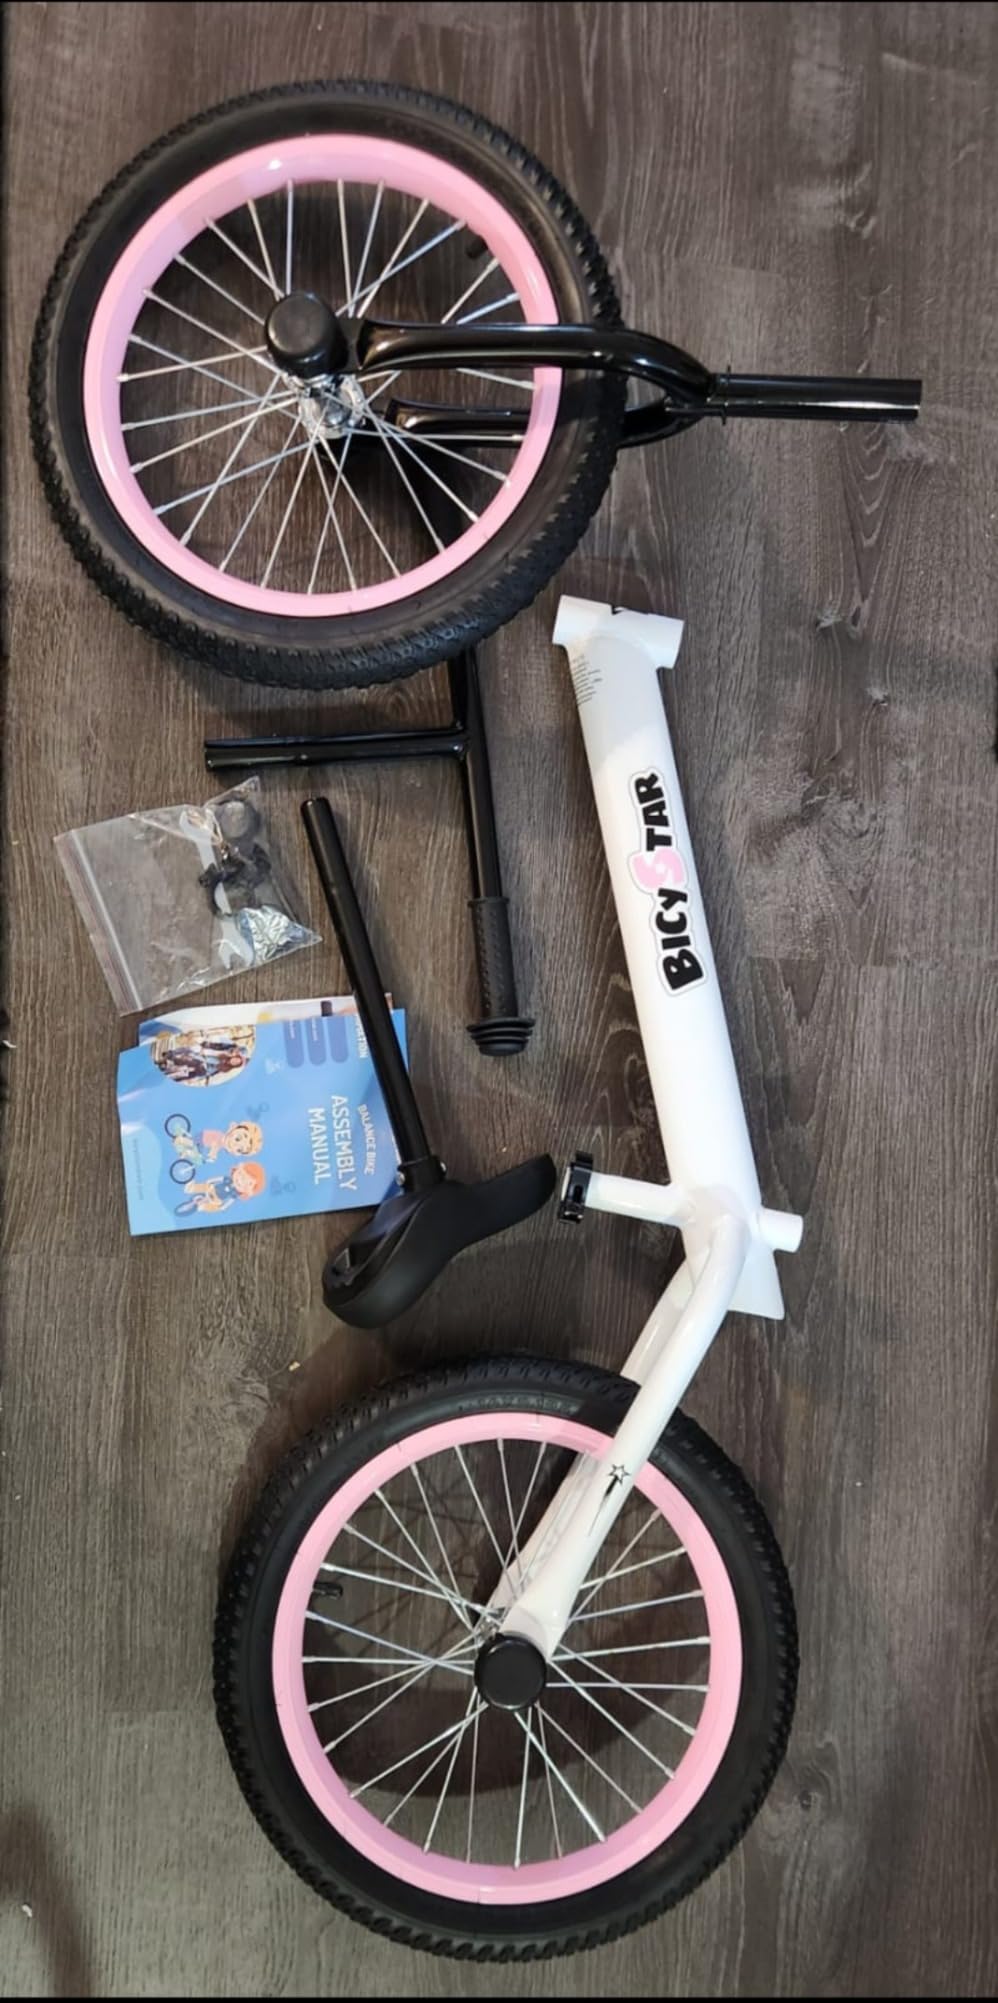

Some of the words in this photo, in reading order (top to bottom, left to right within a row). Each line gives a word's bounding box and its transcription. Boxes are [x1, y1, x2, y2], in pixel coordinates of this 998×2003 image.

[308, 1107, 331, 1184] MANUAL
[331, 1095, 358, 1190] ASSEMBLY
[358, 1104, 376, 1150] BALANCE
[364, 1151, 376, 1175] BIKE
